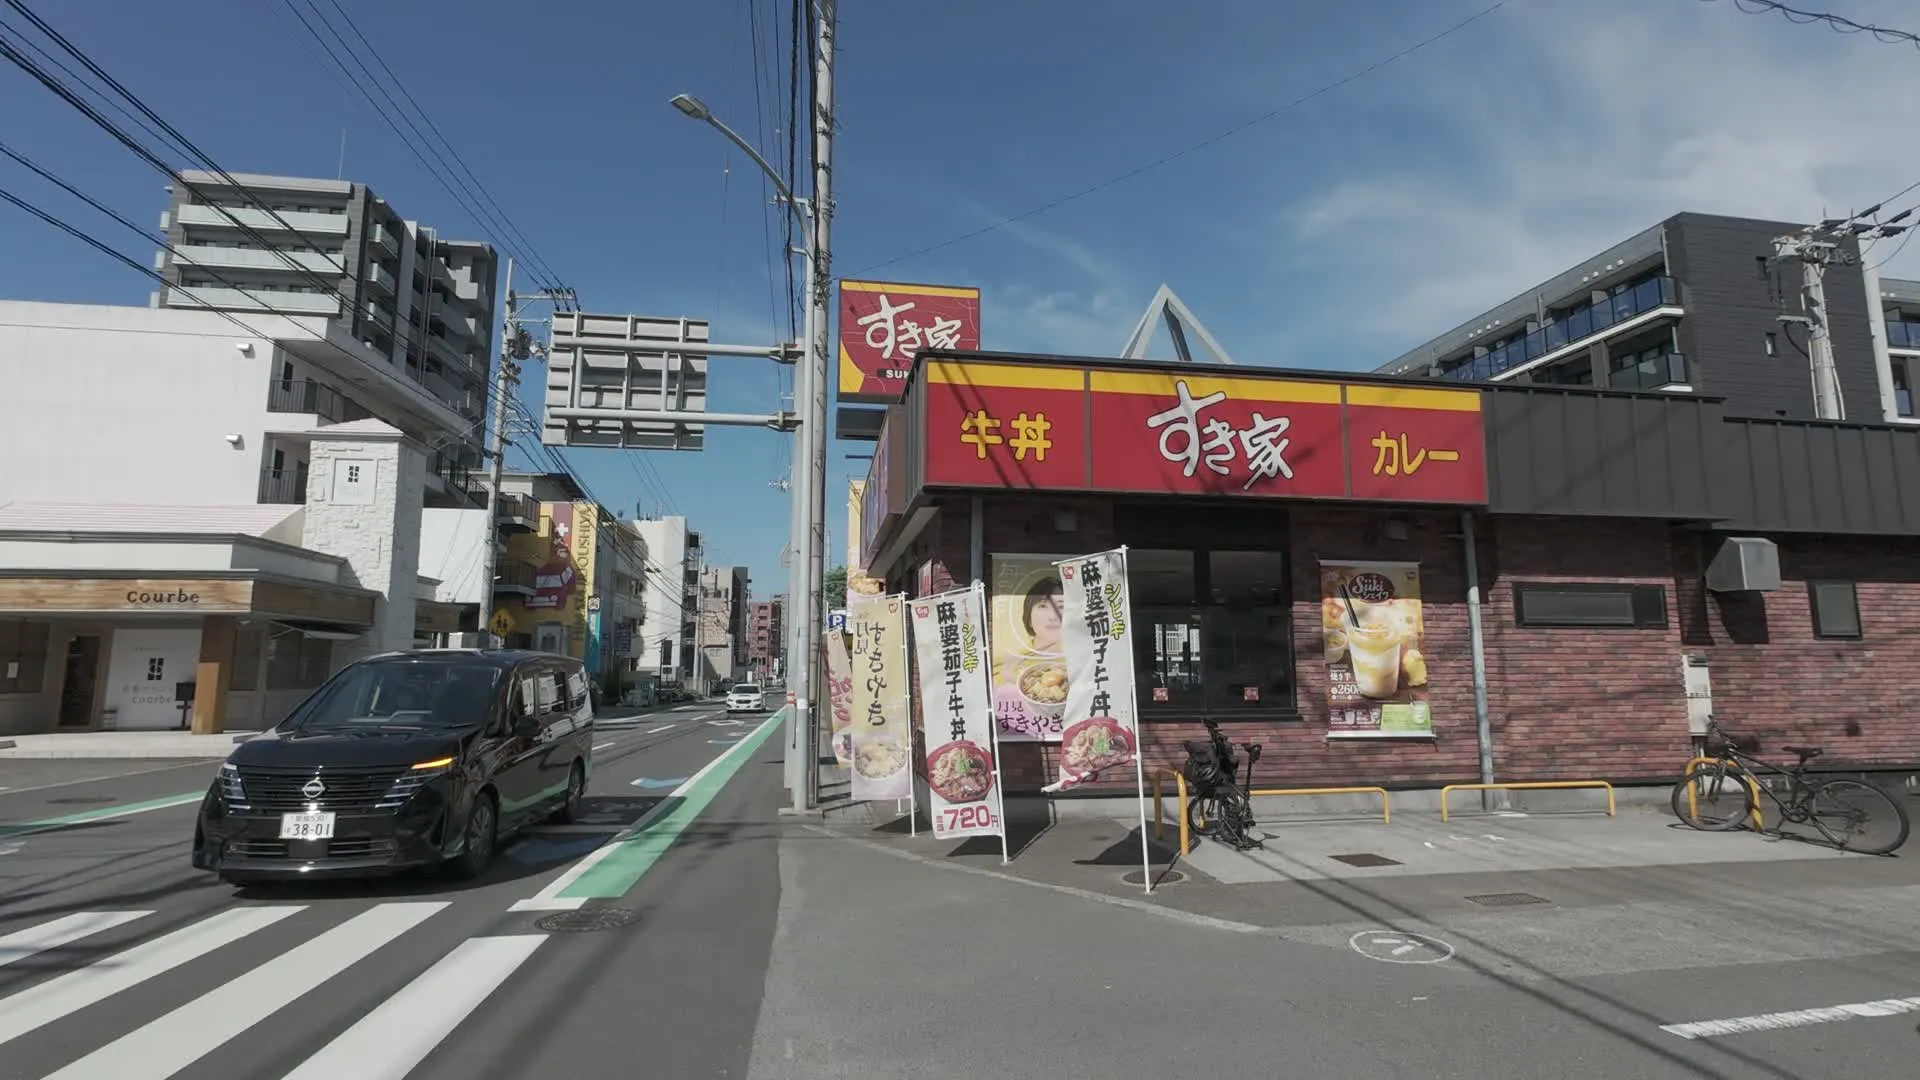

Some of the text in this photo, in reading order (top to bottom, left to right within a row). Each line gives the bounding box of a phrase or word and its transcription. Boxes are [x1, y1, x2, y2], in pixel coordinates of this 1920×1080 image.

[857, 294, 963, 359] すき家
[960, 410, 1053, 461] 牛丼
[1146, 380, 1294, 491] すき家
[1371, 430, 1460, 476] カレー
[832, 615, 843, 627] P
[936, 601, 966, 740] 麻婆茄子牛丼
[996, 713, 1064, 733] すきやき
[292, 823, 331, 836] 38-01
